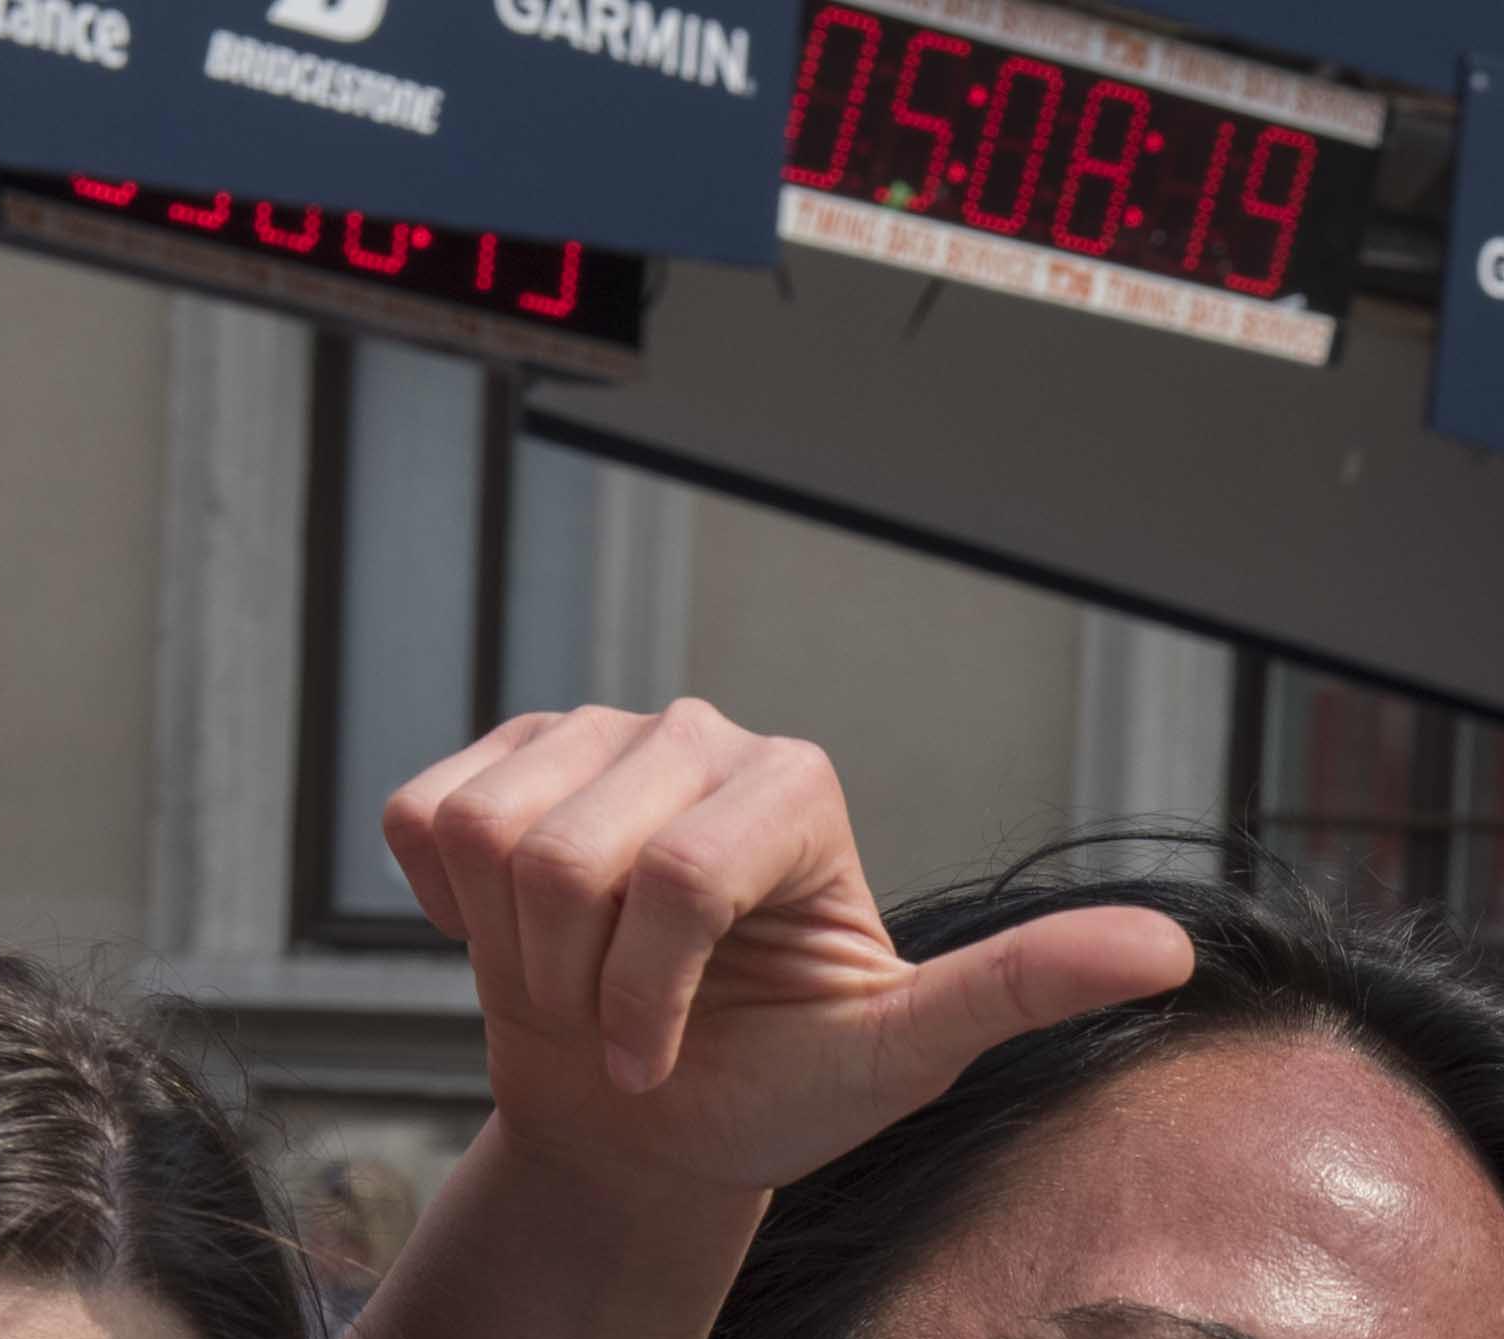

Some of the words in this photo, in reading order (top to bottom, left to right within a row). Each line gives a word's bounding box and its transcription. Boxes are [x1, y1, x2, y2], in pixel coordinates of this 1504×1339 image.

[205, 30, 443, 136] BRIDGESTONE
[494, 0, 754, 95] GARMIN
[782, 5, 1318, 296] 05:08:19
